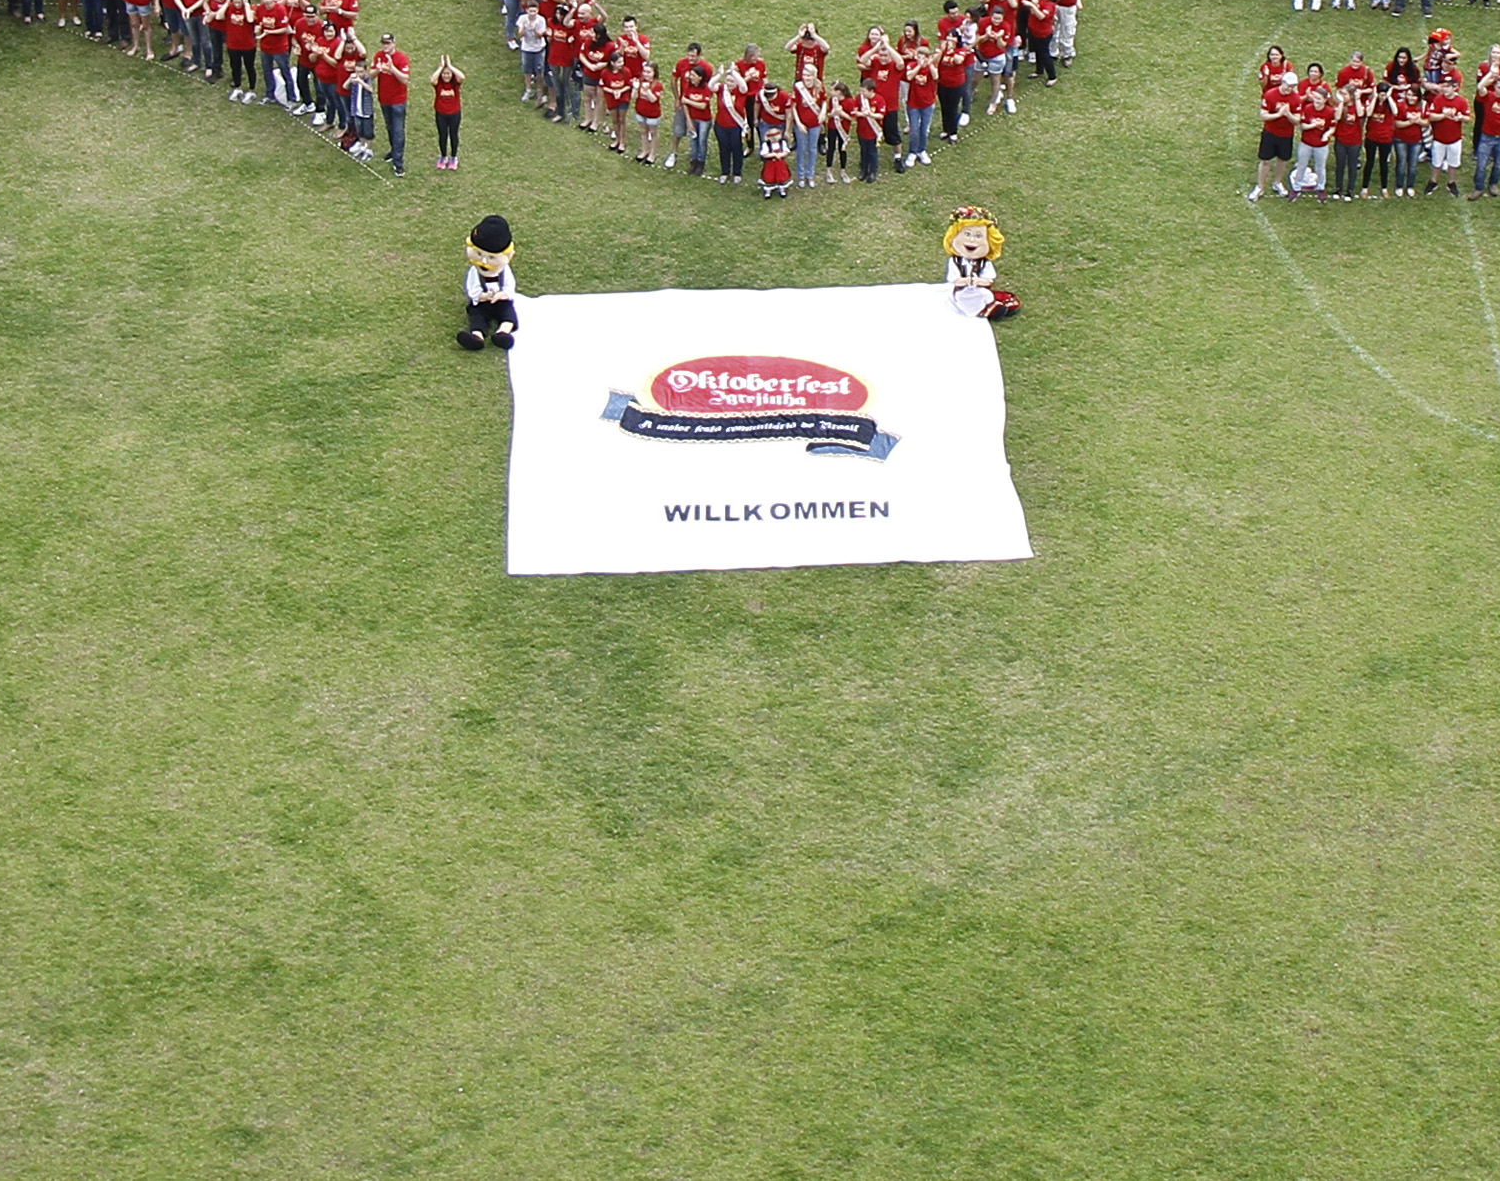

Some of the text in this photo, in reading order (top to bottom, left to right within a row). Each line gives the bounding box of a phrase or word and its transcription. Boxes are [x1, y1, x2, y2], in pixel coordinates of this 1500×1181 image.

[667, 370, 851, 395] Oktoberfest
[709, 390, 807, 407] Igrejinha
[664, 501, 889, 522] WILLKOMMEN
